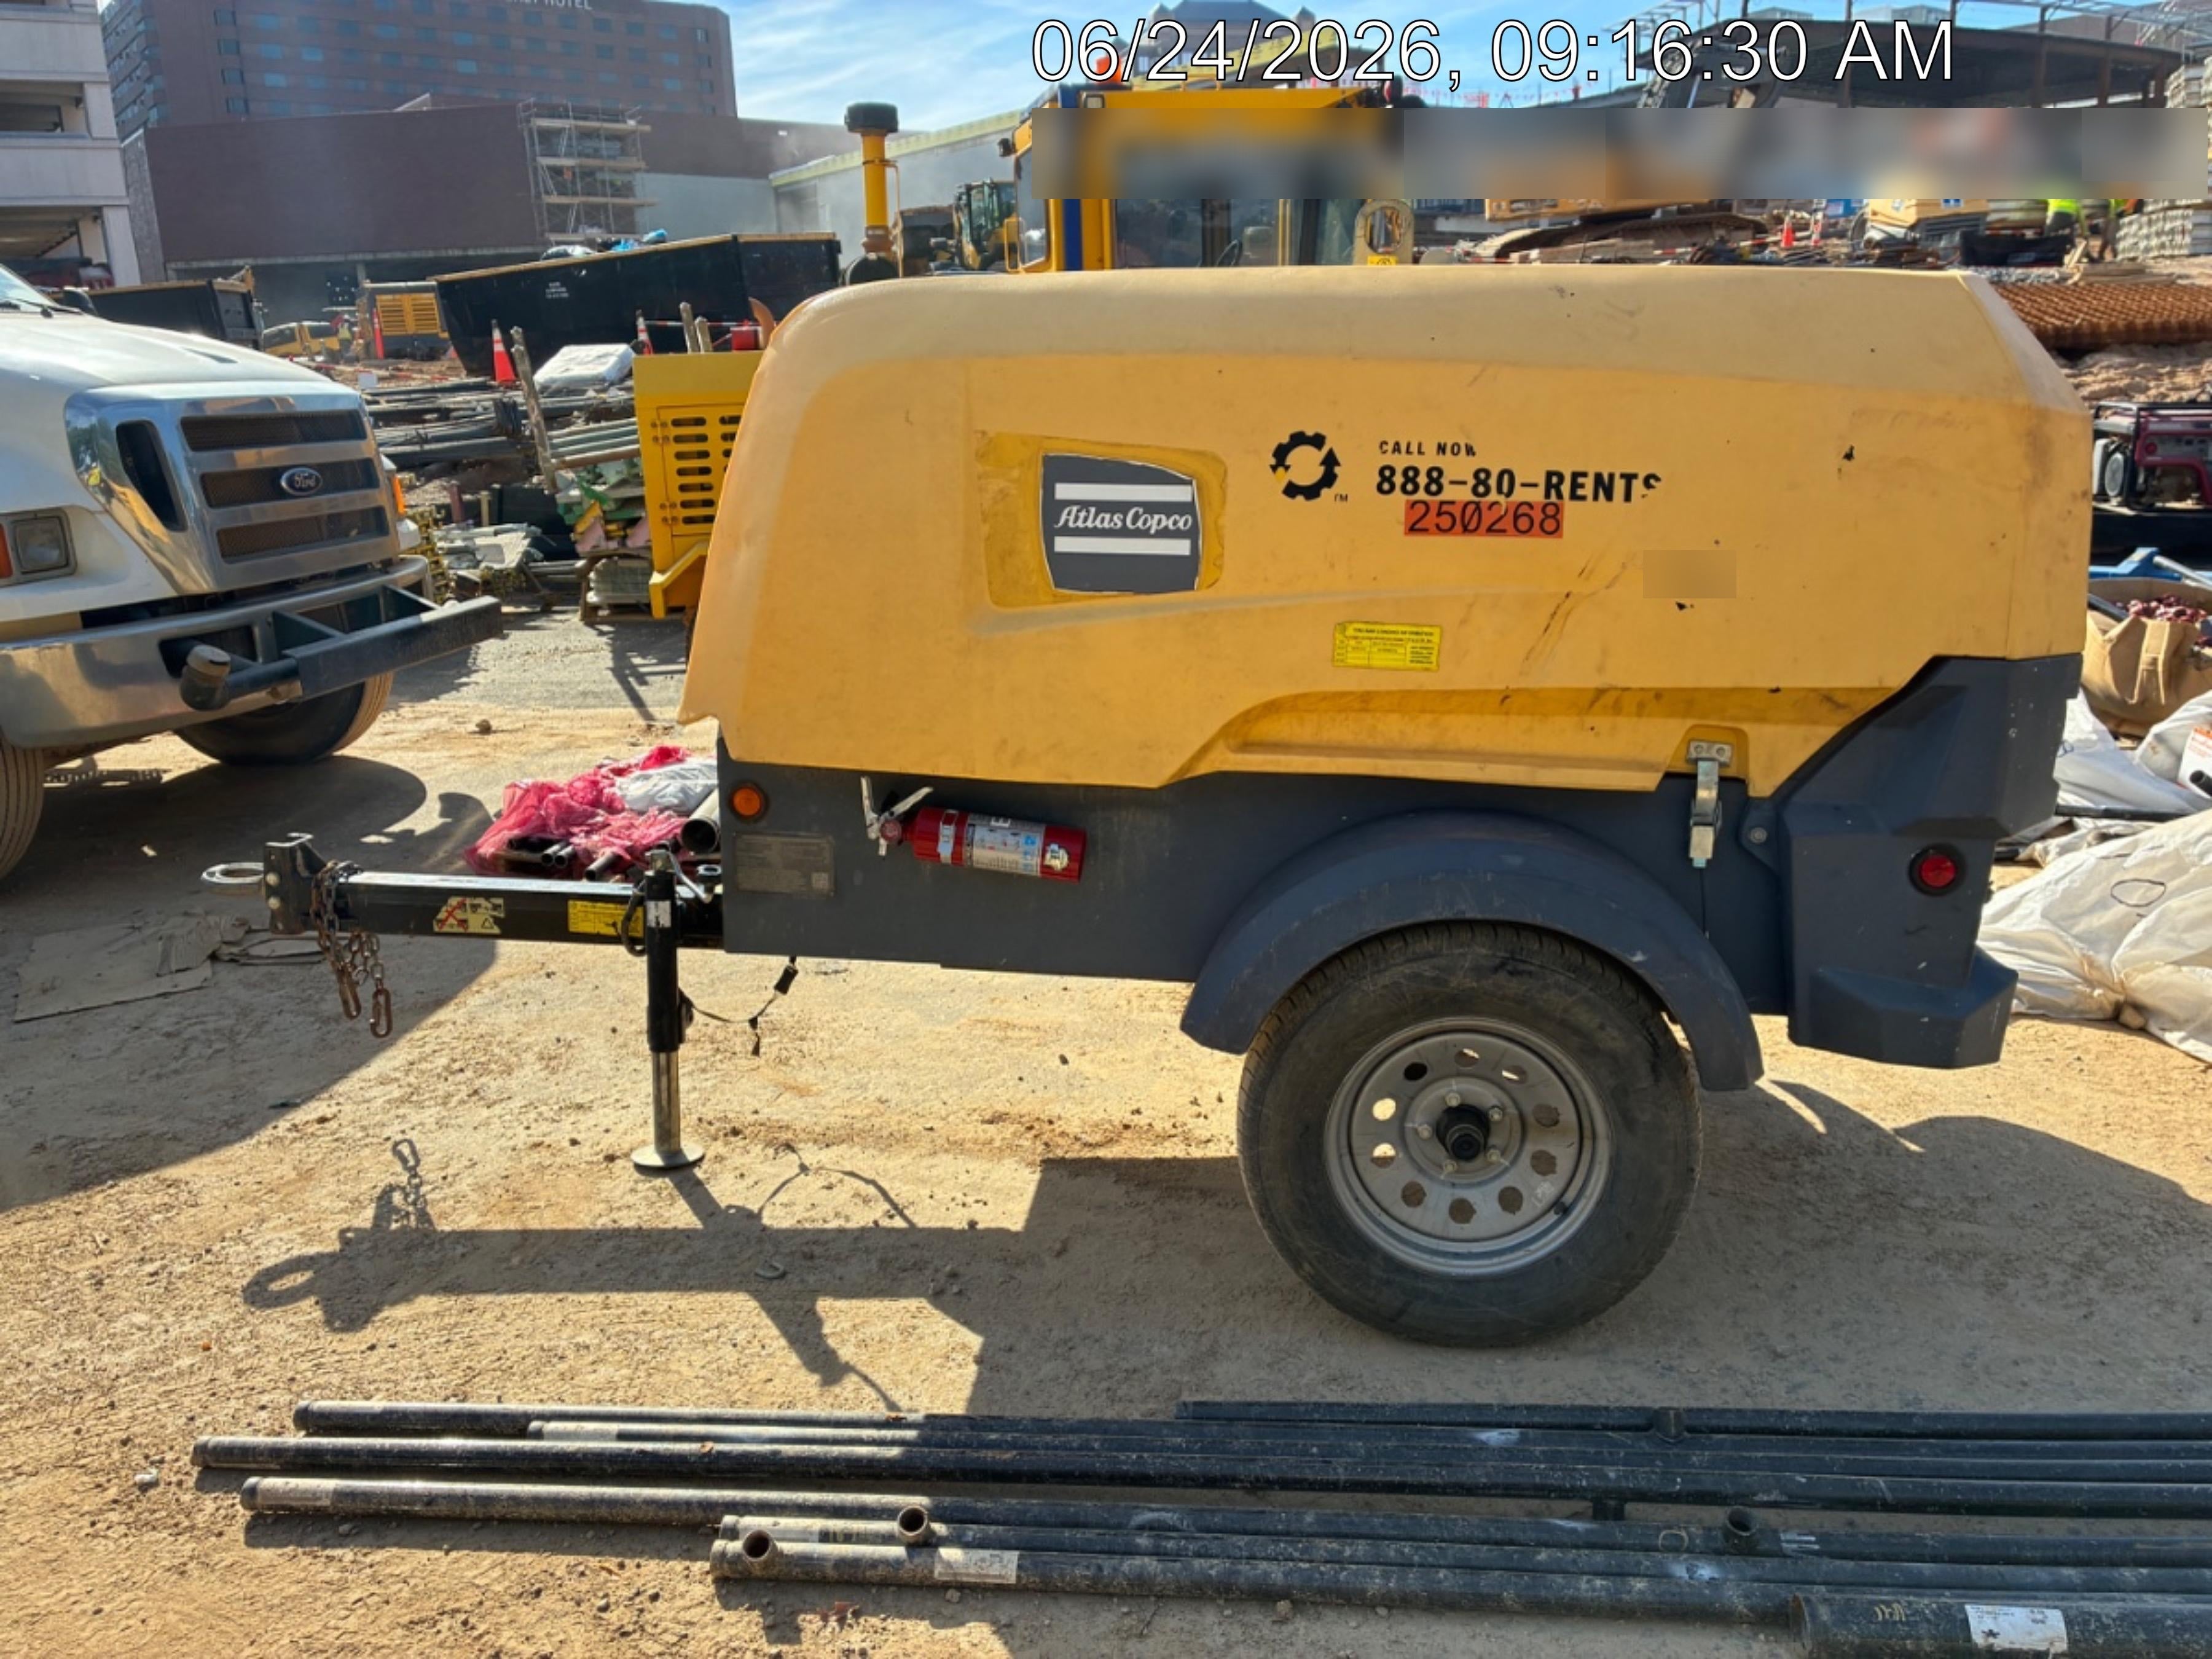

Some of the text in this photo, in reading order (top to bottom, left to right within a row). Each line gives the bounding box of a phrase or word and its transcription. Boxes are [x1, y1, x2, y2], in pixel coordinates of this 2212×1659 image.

[1379, 440, 1425, 455] CALL
[1054, 504, 1192, 535] Atlas Copco
[1408, 500, 1561, 535] 250268
